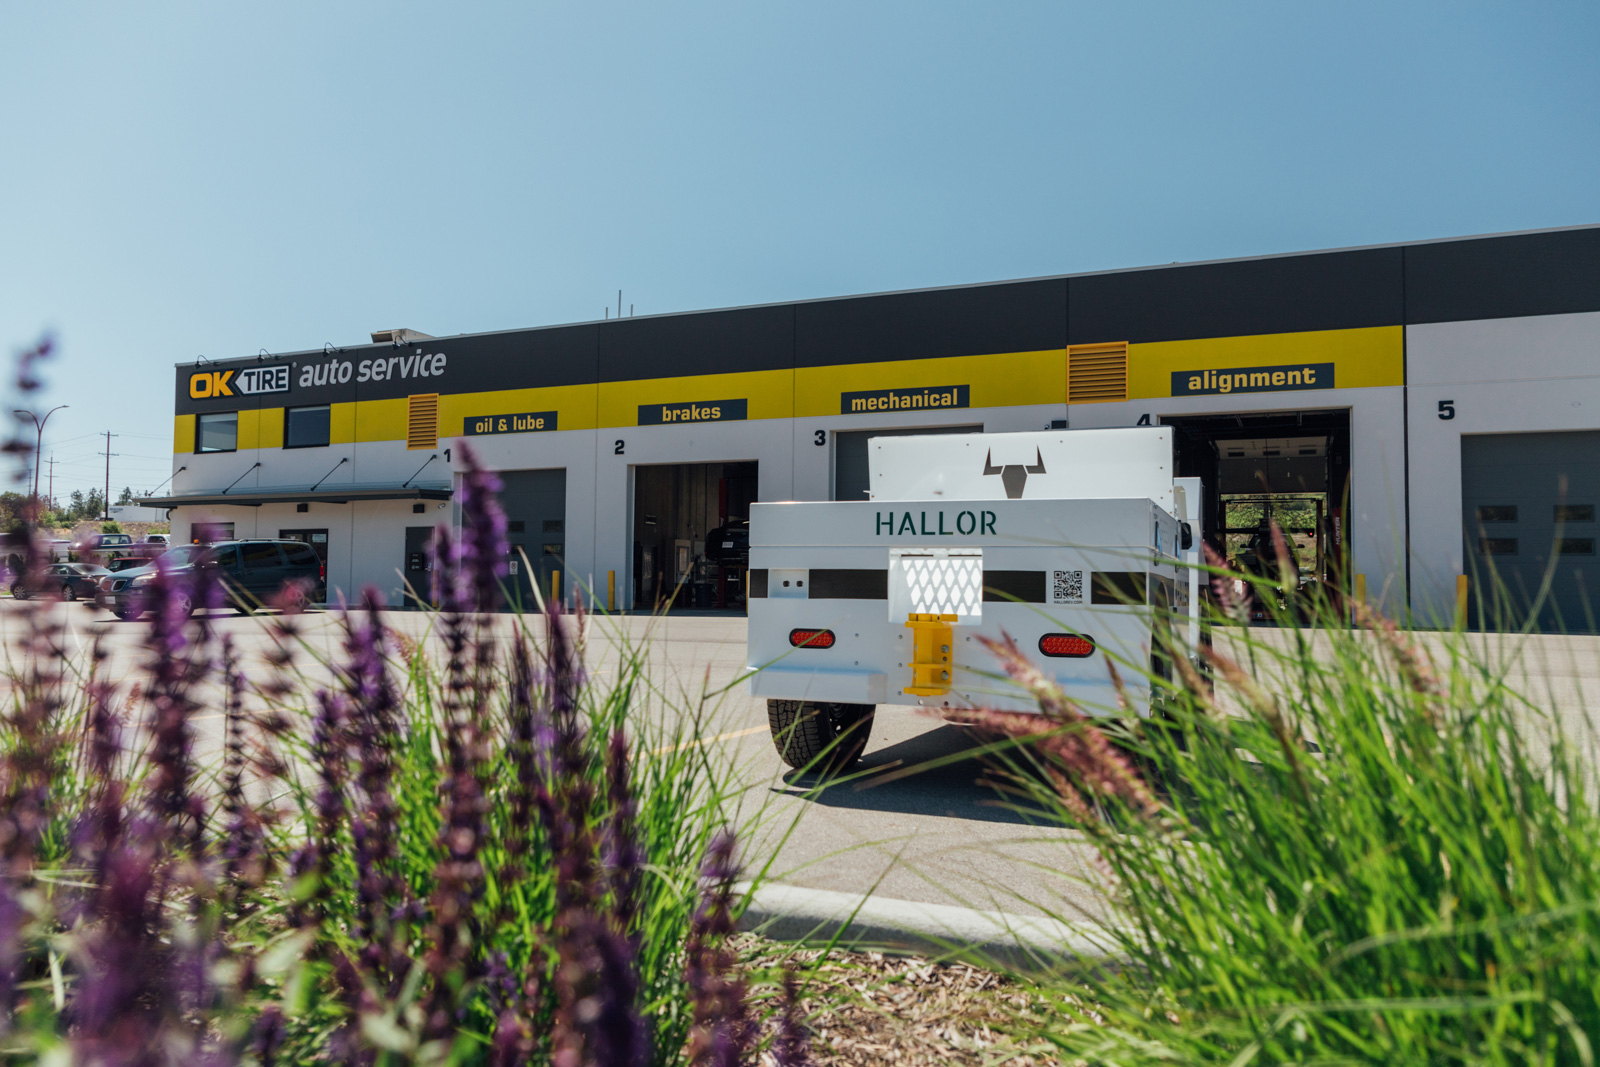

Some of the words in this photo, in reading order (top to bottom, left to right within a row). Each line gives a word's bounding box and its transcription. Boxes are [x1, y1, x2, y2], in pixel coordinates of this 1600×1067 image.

[299, 358, 353, 388] auto
[356, 349, 447, 382] service
[189, 370, 235, 399] OK
[244, 368, 288, 392] TIRE
[1188, 367, 1316, 393] alignment
[851, 388, 958, 411] mechanical
[662, 404, 721, 422] brakes
[1136, 413, 1152, 426] 4
[1437, 400, 1456, 420] 5
[475, 418, 493, 433] oil
[498, 418, 508, 432] &
[513, 415, 545, 431] lube
[614, 439, 625, 455] 2
[814, 429, 826, 446] 3
[443, 448, 451, 462] 1
[876, 510, 997, 536] HALLOR
